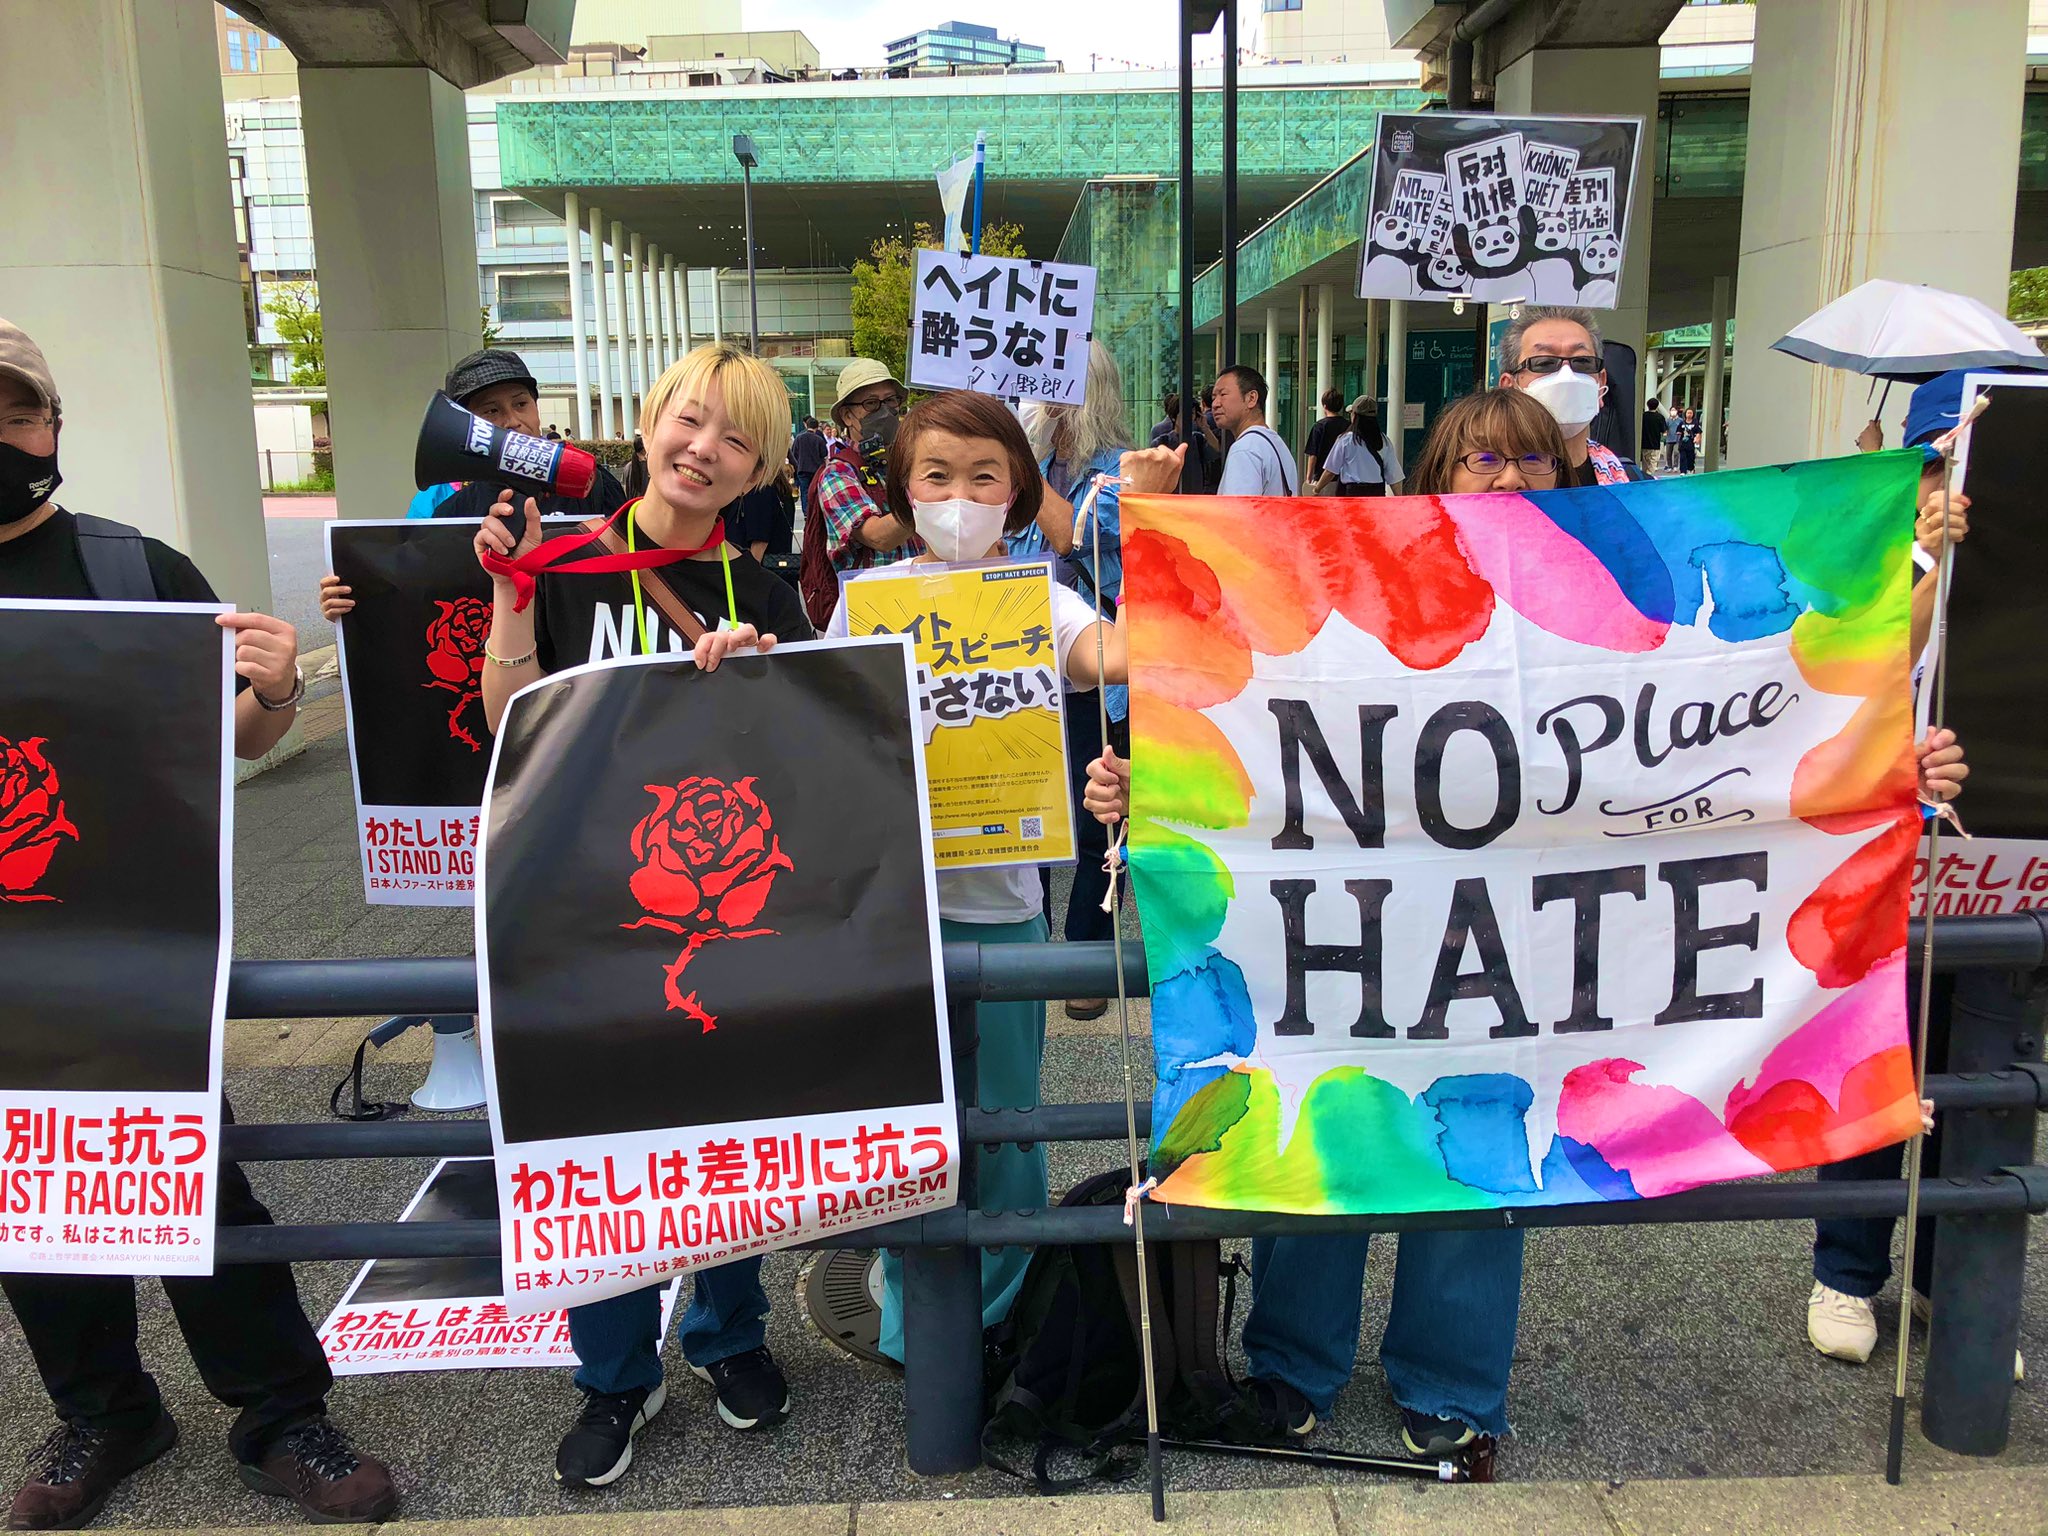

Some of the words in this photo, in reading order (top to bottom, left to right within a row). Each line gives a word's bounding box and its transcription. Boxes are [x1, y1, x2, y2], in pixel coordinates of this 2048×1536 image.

[1457, 146, 1507, 187] 反对
[1525, 150, 1572, 179] KHÔNG
[1398, 176, 1422, 200] NO
[1421, 188, 1434, 201] to
[1462, 178, 1517, 222] 仇恨
[1526, 178, 1560, 208] GHÉT
[1563, 177, 1608, 205] 差別
[1394, 199, 1432, 224] HATE
[923, 265, 1079, 317] ヘイトに
[921, 310, 1069, 371] 酔うな！
[502, 457, 548, 480] すんな
[1004, 571, 1020, 579] HATE
[1268, 698, 1521, 850] NO
[1536, 680, 1799, 815] Place
[1646, 797, 1714, 830] FOR
[367, 849, 374, 873] I
[378, 849, 441, 875] STAND
[1270, 850, 1768, 1040] HATE
[2, 1107, 207, 1165] 別に抗う
[511, 1122, 949, 1213] わたしは差別に抗う
[64, 1170, 204, 1216] RACISM
[513, 1219, 522, 1263] I
[533, 1208, 646, 1262] STAND
[656, 1196, 805, 1251] AGAINST
[818, 1171, 948, 1221] RACISM
[331, 1330, 426, 1353] STAND
[427, 1324, 551, 1348] AGAINST
